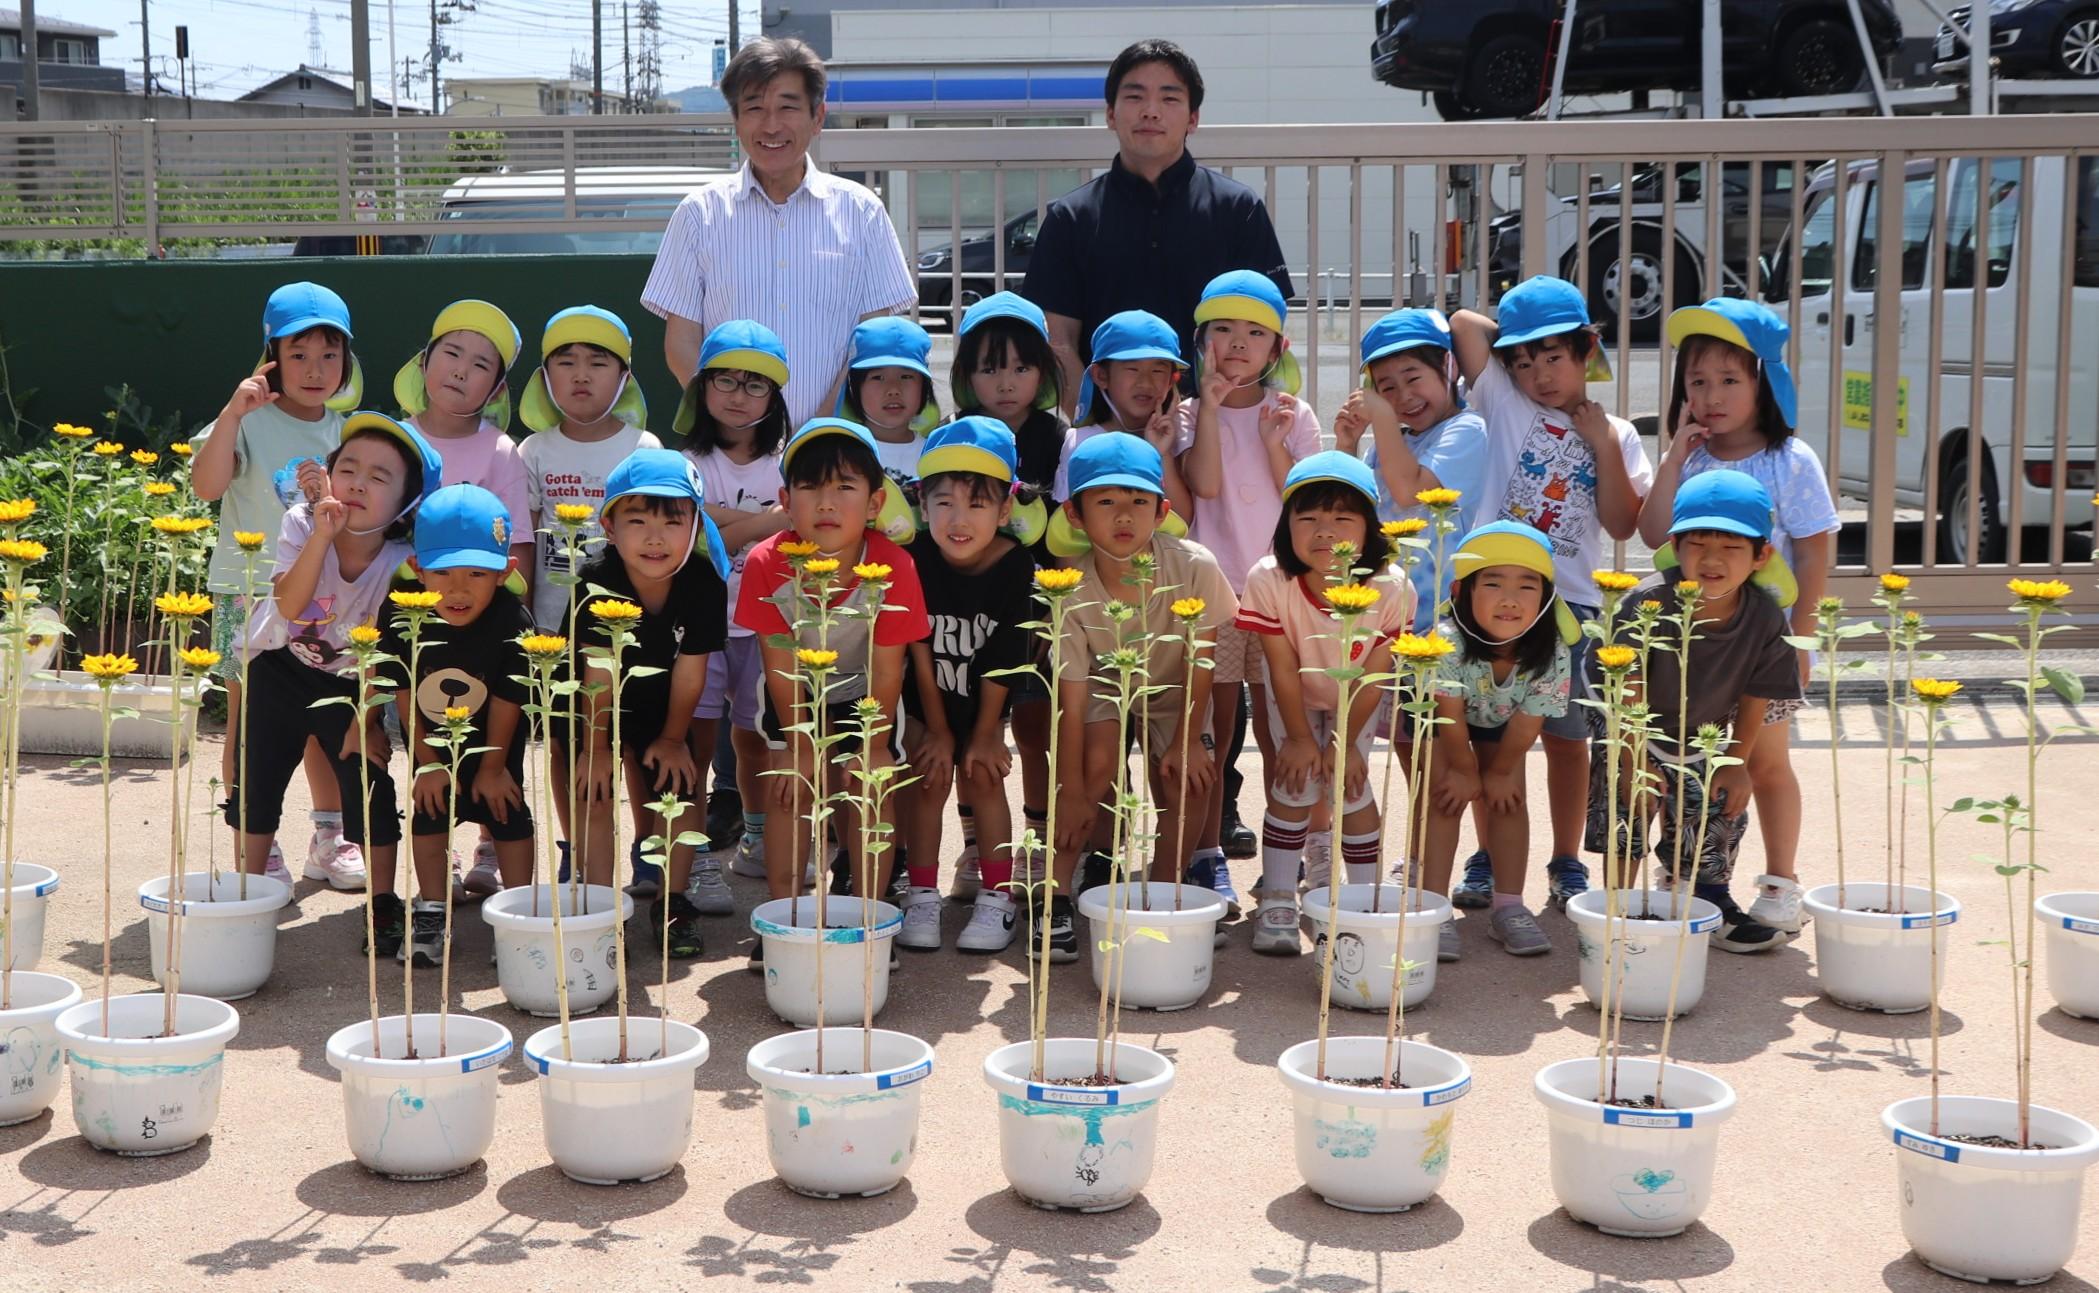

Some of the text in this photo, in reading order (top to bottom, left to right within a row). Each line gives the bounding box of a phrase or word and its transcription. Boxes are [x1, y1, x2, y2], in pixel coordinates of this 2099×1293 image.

[545, 474, 582, 486] Gotta
[546, 486, 605, 498] catch 'em
[1051, 1092, 1073, 1101] やすい
